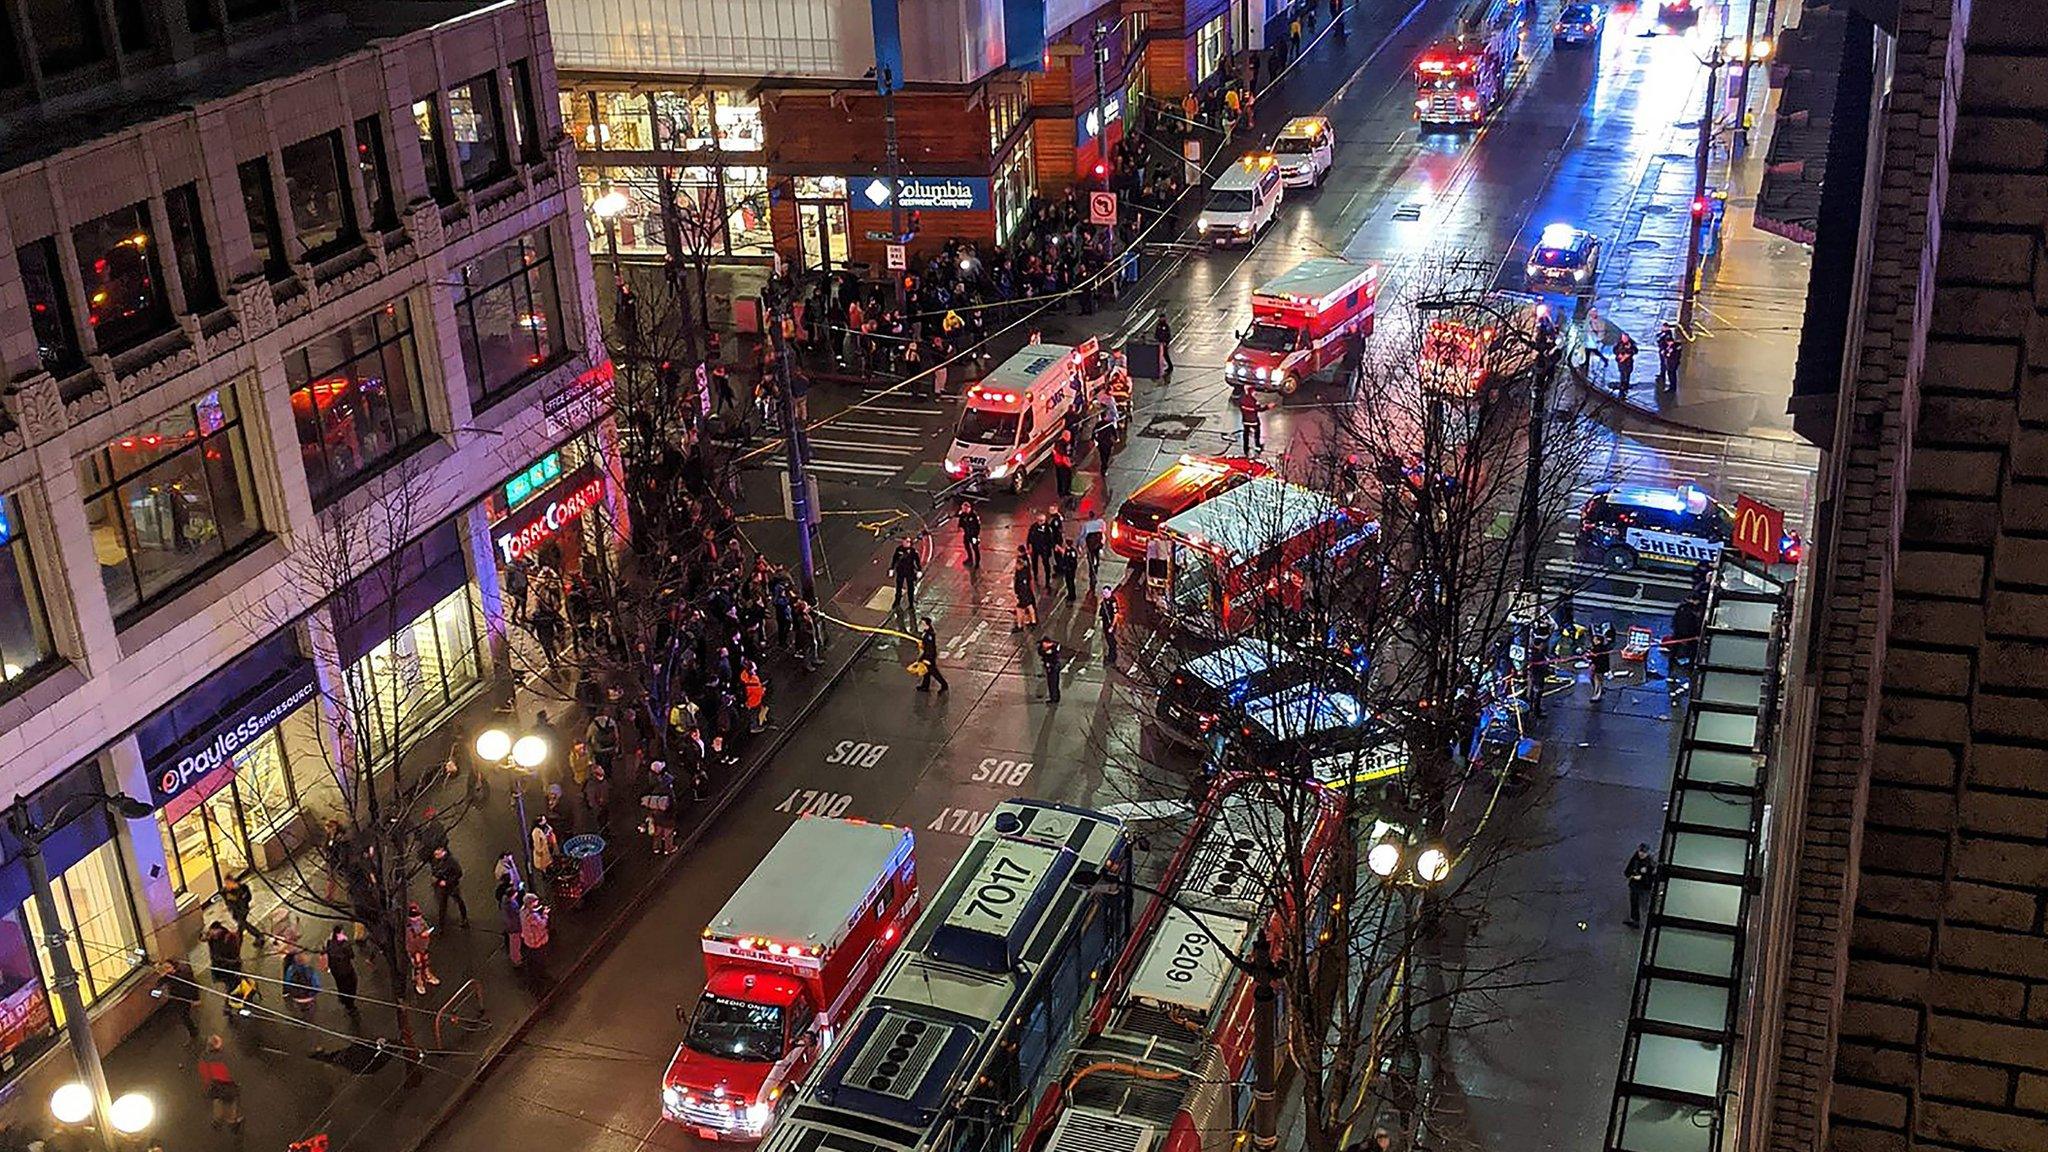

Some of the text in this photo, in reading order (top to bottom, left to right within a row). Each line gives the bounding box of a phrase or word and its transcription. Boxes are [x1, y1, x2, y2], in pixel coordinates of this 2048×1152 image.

[1640, 537, 1719, 561] SHERIFF
[178, 715, 260, 784] Payless
[827, 740, 889, 768] BUS
[971, 758, 1034, 787] BUS
[1330, 754, 1403, 780] SERIF
[774, 788, 853, 818] ONLY
[927, 807, 990, 837] NLY
[964, 856, 1031, 919] 7017
[1165, 932, 1210, 983] 6209
[717, 998, 746, 1008] MEDIC
